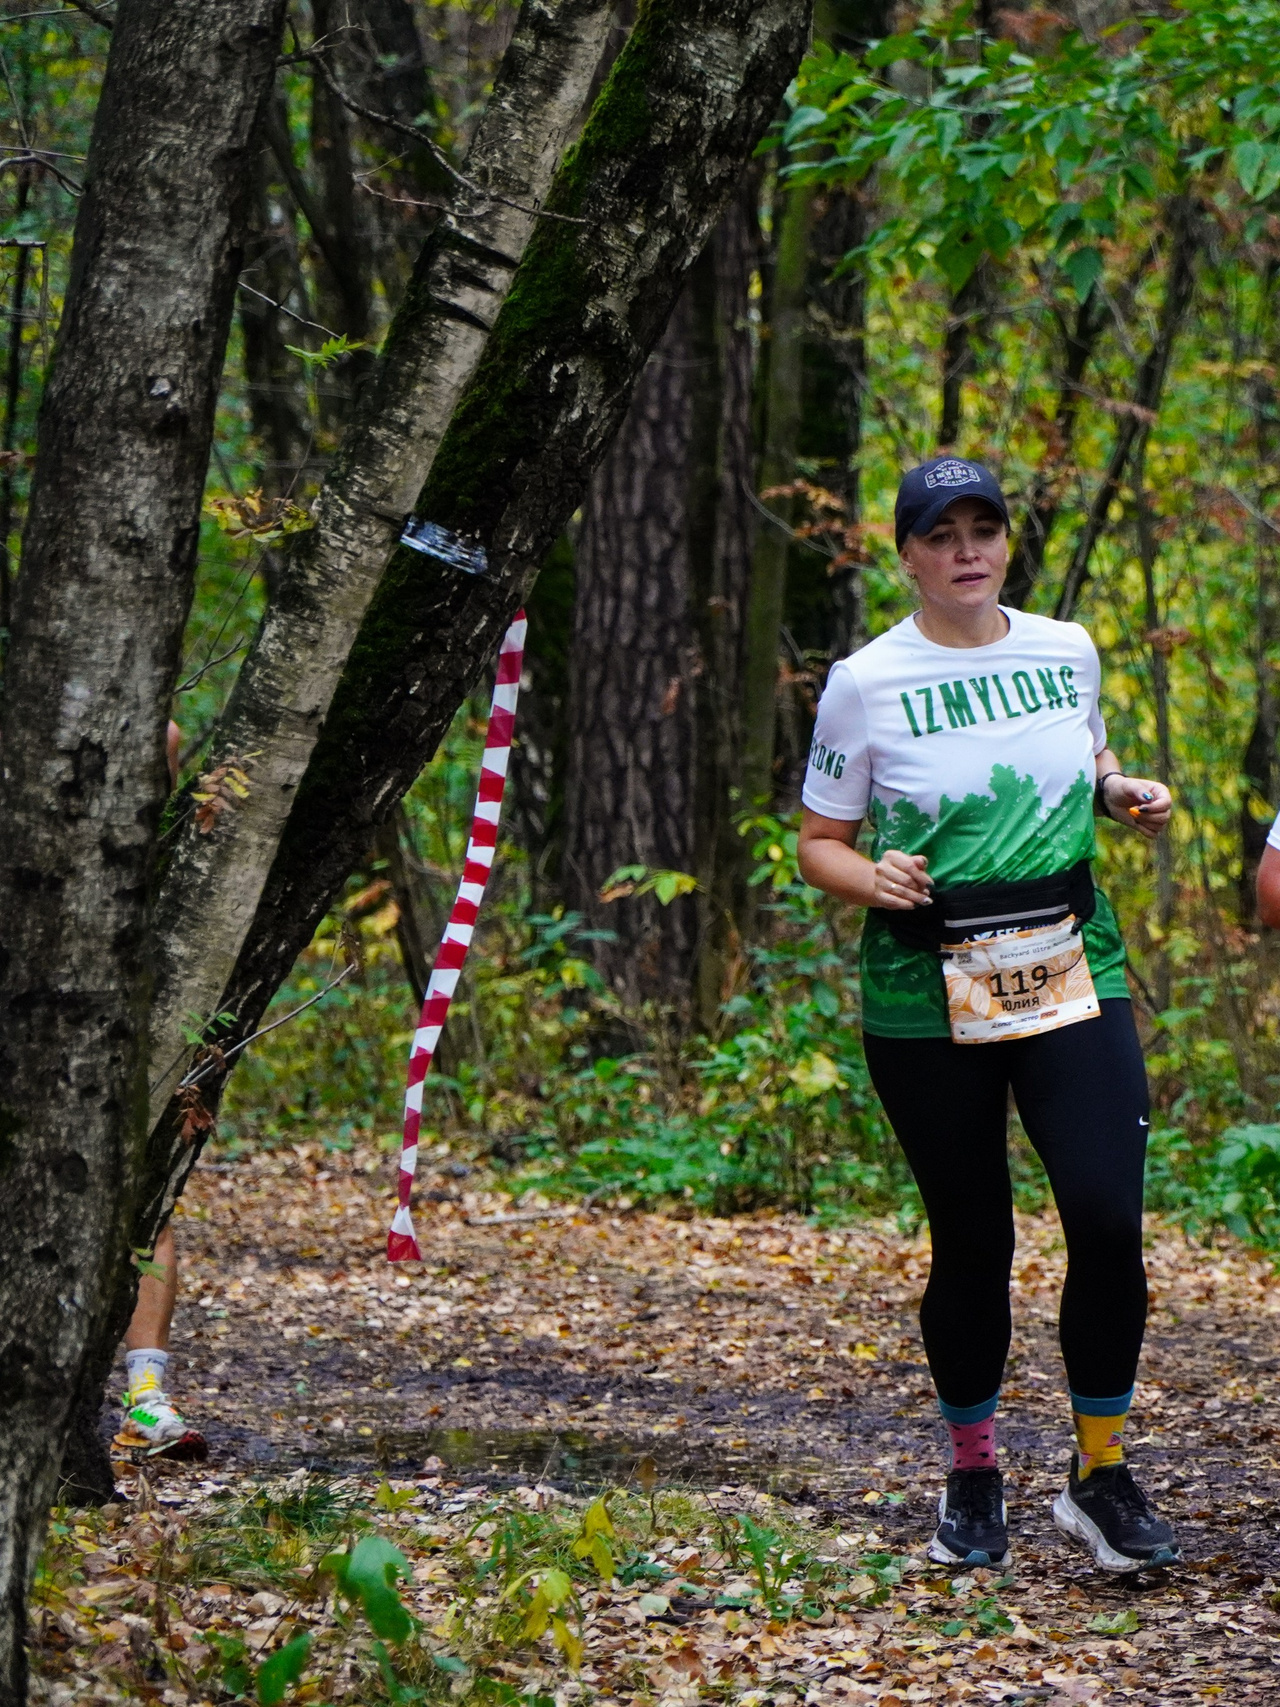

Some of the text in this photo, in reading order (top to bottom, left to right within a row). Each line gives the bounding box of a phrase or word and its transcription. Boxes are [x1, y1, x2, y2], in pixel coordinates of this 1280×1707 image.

[900, 665, 1079, 738] IZMYLONG
[1000, 949, 1030, 961] Backyard
[1033, 944, 1051, 954] Ultra
[989, 965, 1048, 998] 119
[1001, 996, 1040, 1012] Юлия
[1040, 1009, 1058, 1020] PRO
